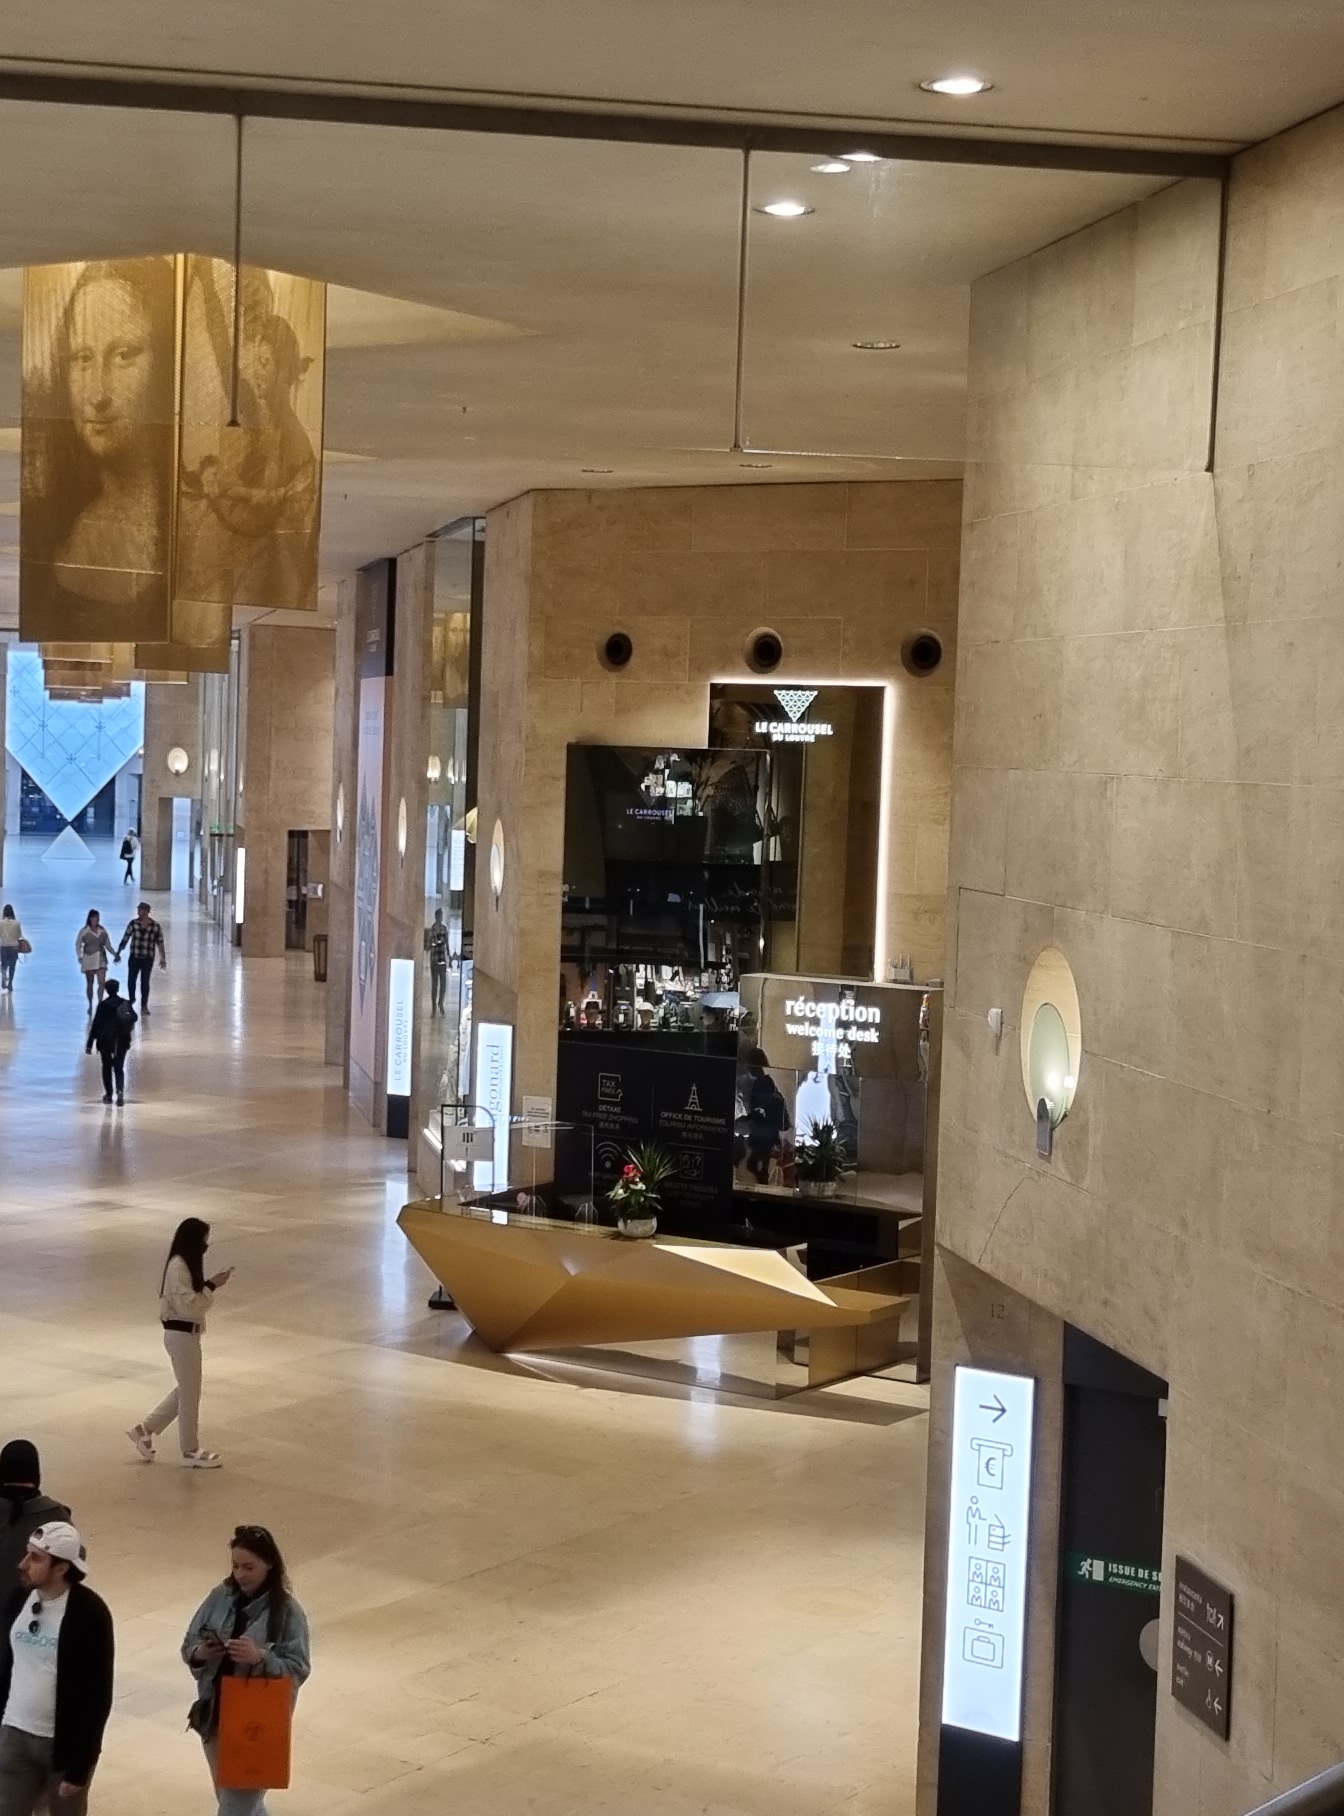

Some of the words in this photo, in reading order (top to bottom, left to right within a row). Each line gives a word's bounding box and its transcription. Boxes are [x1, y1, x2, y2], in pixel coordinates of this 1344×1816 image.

[755, 721, 768, 734] LE
[769, 722, 834, 736] CARROUSEL
[785, 996, 881, 1024] réception
[786, 1022, 844, 1041] welcome
[848, 1026, 880, 1043] desk
[601, 1087, 617, 1095] FREE
[602, 1079, 617, 1088] TAX
[660, 1111, 683, 1119] OFFICE
[1108, 1562, 1136, 1577] ISSUE
[1138, 1568, 1150, 1580] DE
